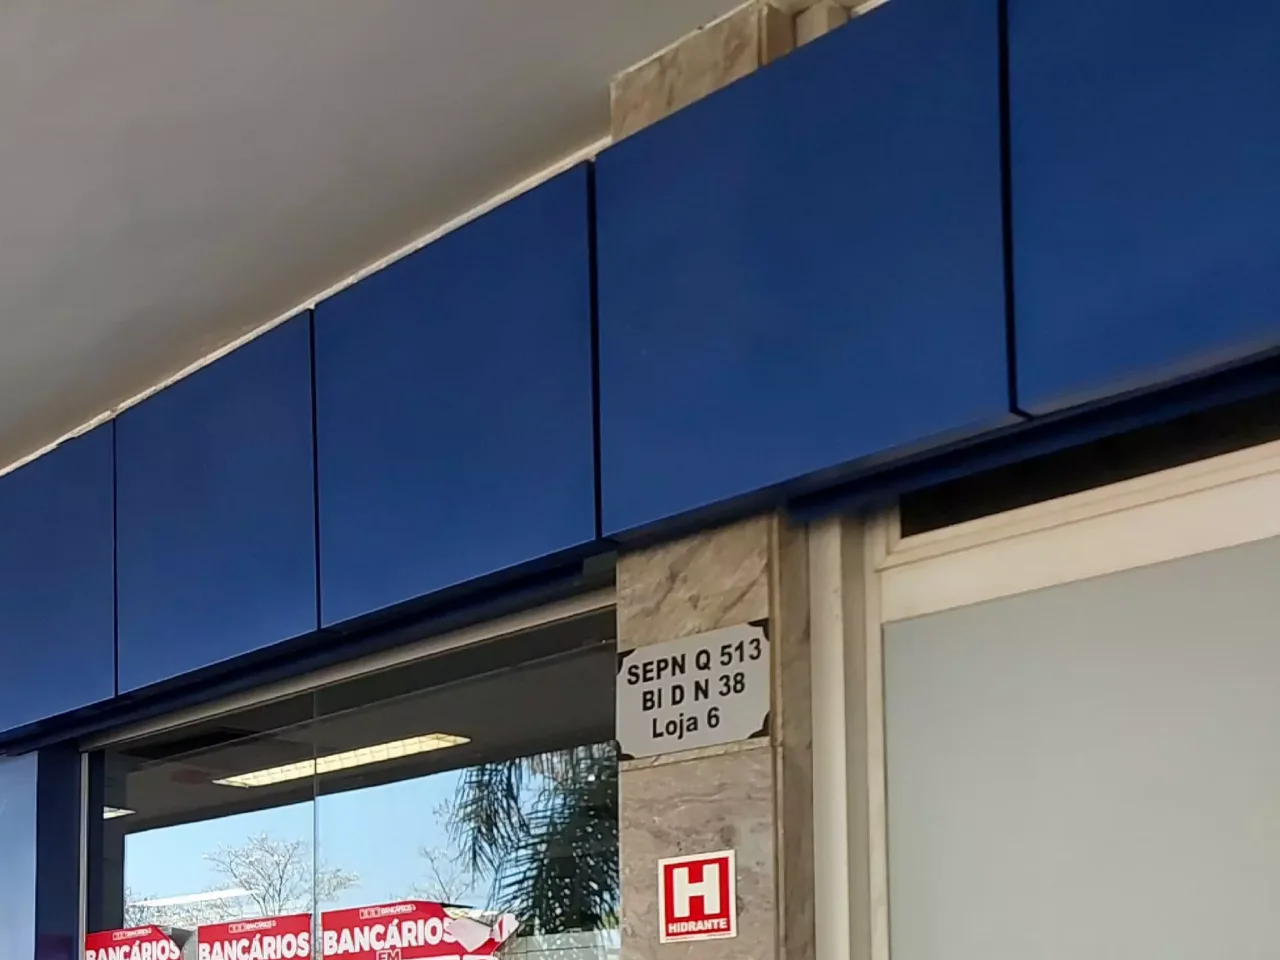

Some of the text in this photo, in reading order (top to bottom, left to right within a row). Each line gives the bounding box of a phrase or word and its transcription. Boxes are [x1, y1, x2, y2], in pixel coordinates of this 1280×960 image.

[627, 638, 762, 686] SEPN Q 513
[671, 685, 684, 706] D
[694, 679, 709, 701] N
[719, 672, 745, 697] 38
[652, 707, 720, 740] Loja 6
[673, 863, 720, 918] H
[324, 916, 458, 956] BANCÁRIOS
[668, 918, 728, 934] HIDRANTE
